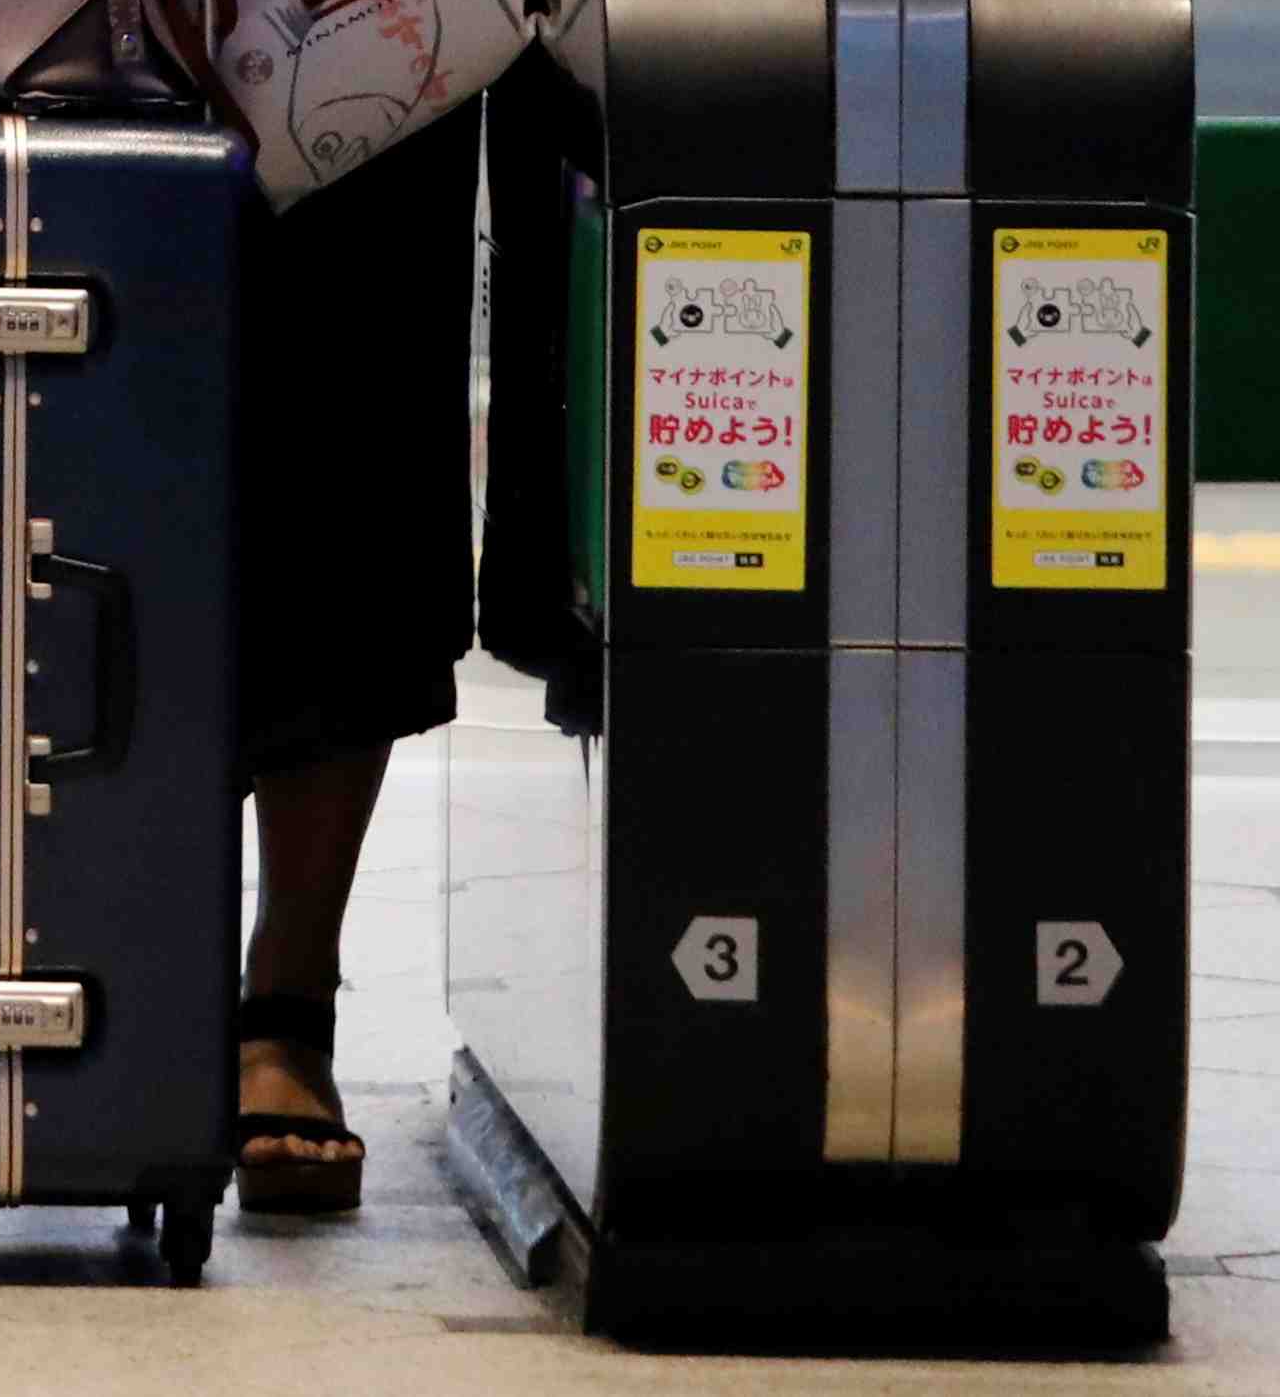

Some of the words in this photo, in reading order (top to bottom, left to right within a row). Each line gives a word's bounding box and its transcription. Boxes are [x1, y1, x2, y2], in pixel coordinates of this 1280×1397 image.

[1007, 367, 1152, 387] マイナポイントは
[649, 414, 793, 447] 貯めよう!
[1007, 414, 1152, 446] 貯めよう!
[703, 933, 739, 981] 3
[1055, 939, 1089, 986] 2
